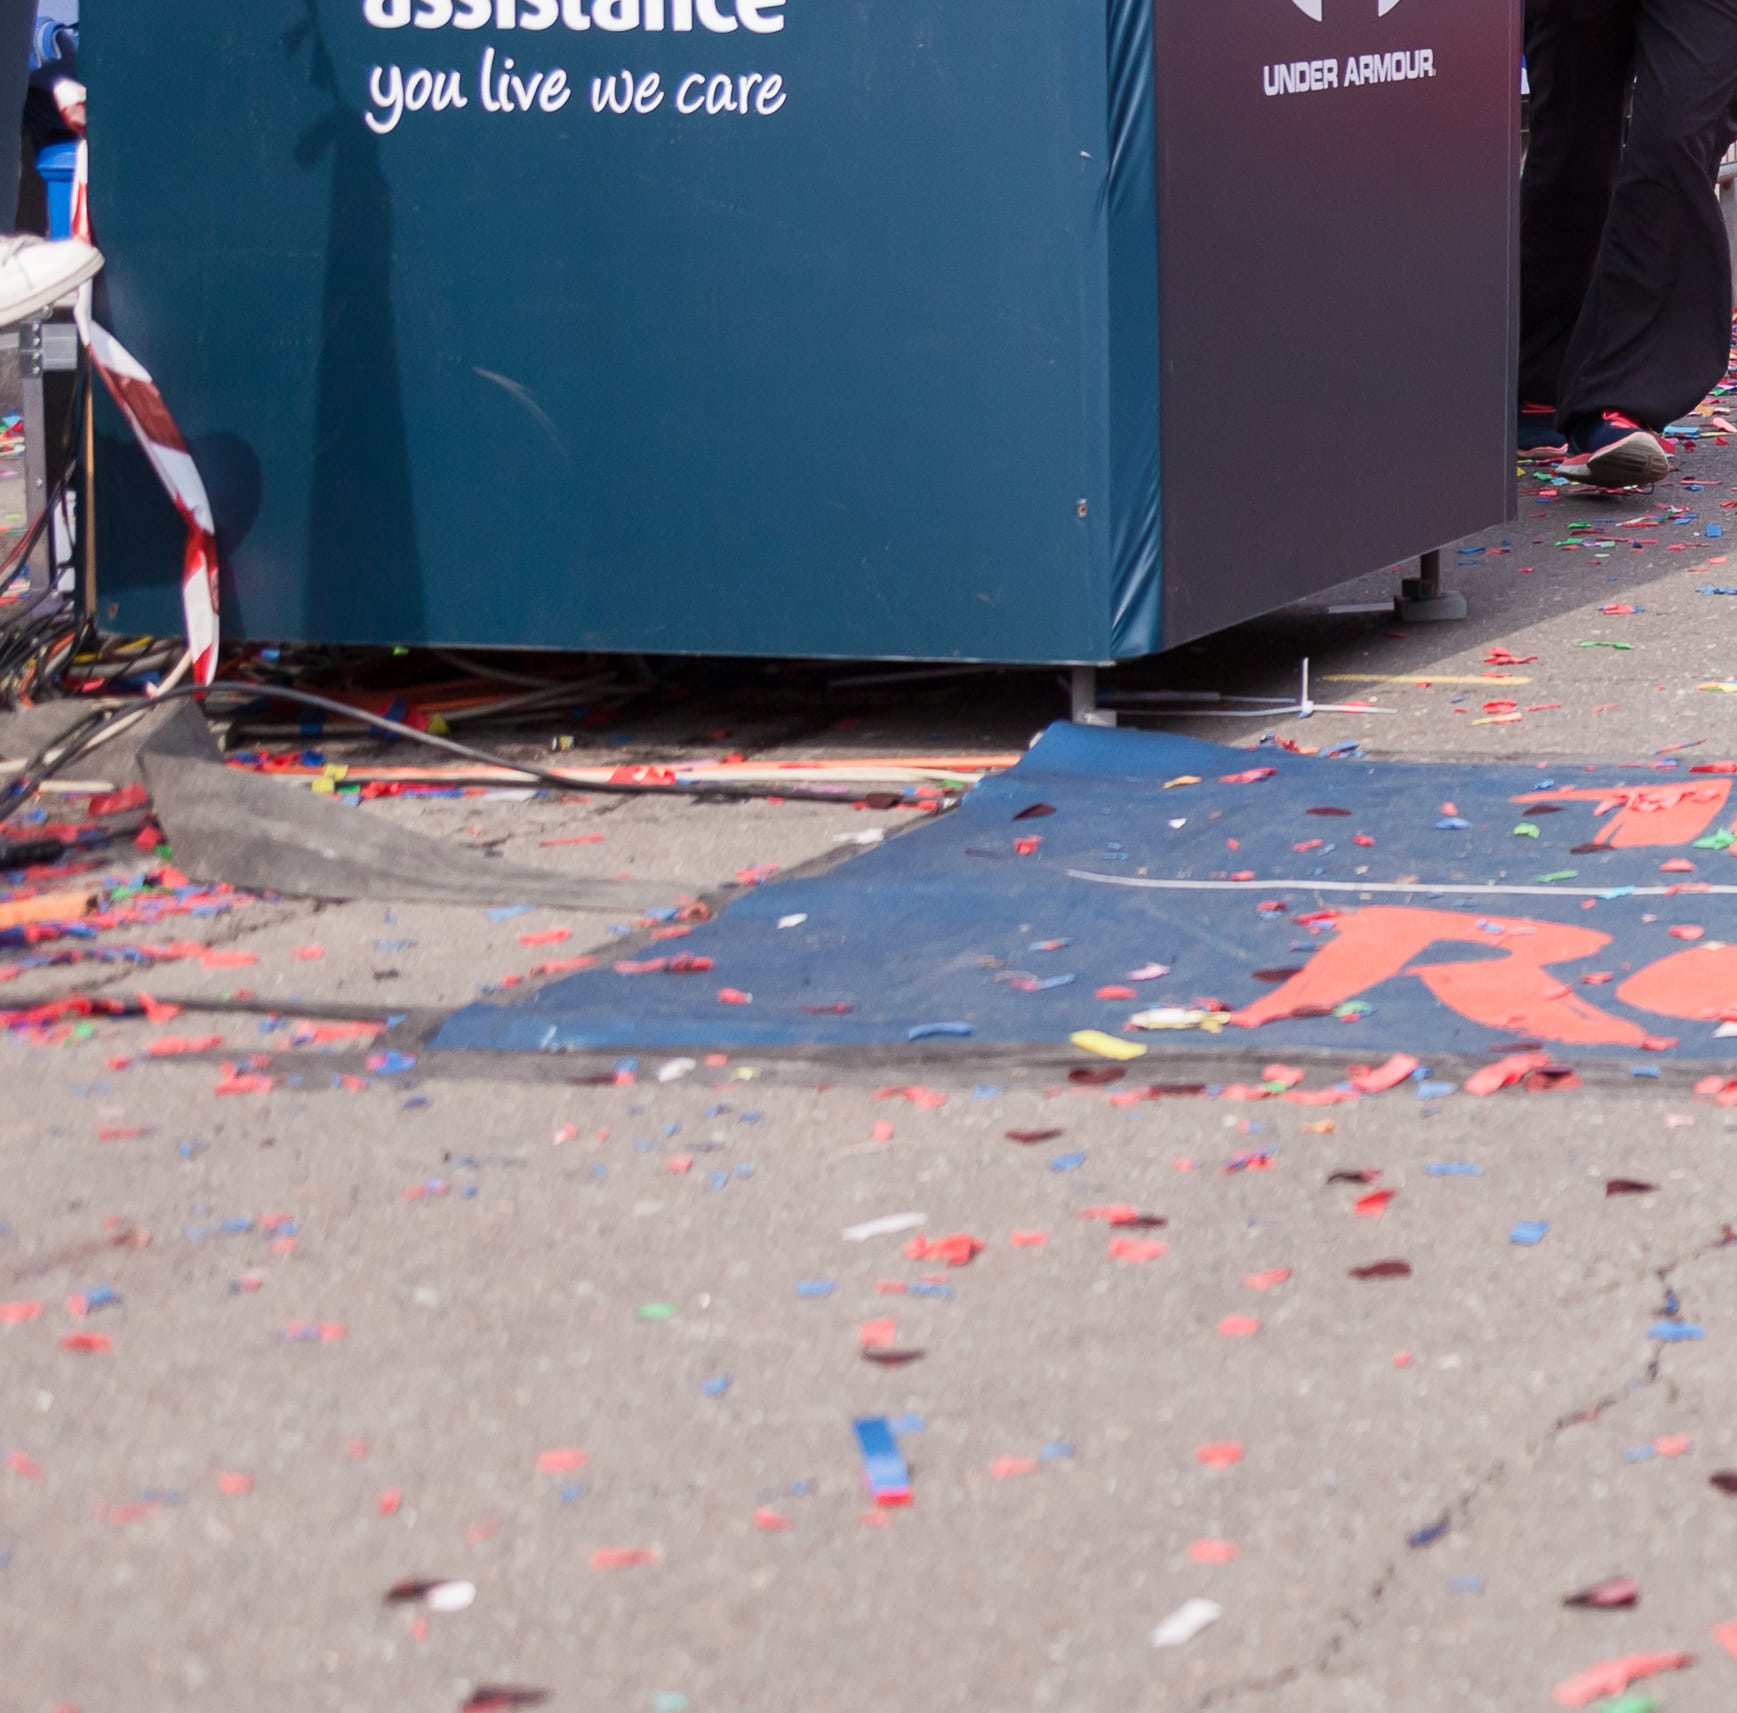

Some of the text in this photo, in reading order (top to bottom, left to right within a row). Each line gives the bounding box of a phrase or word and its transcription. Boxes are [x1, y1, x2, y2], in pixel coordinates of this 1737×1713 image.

[365, 47, 787, 133] you live we care
[1262, 54, 1338, 96] UNDER
